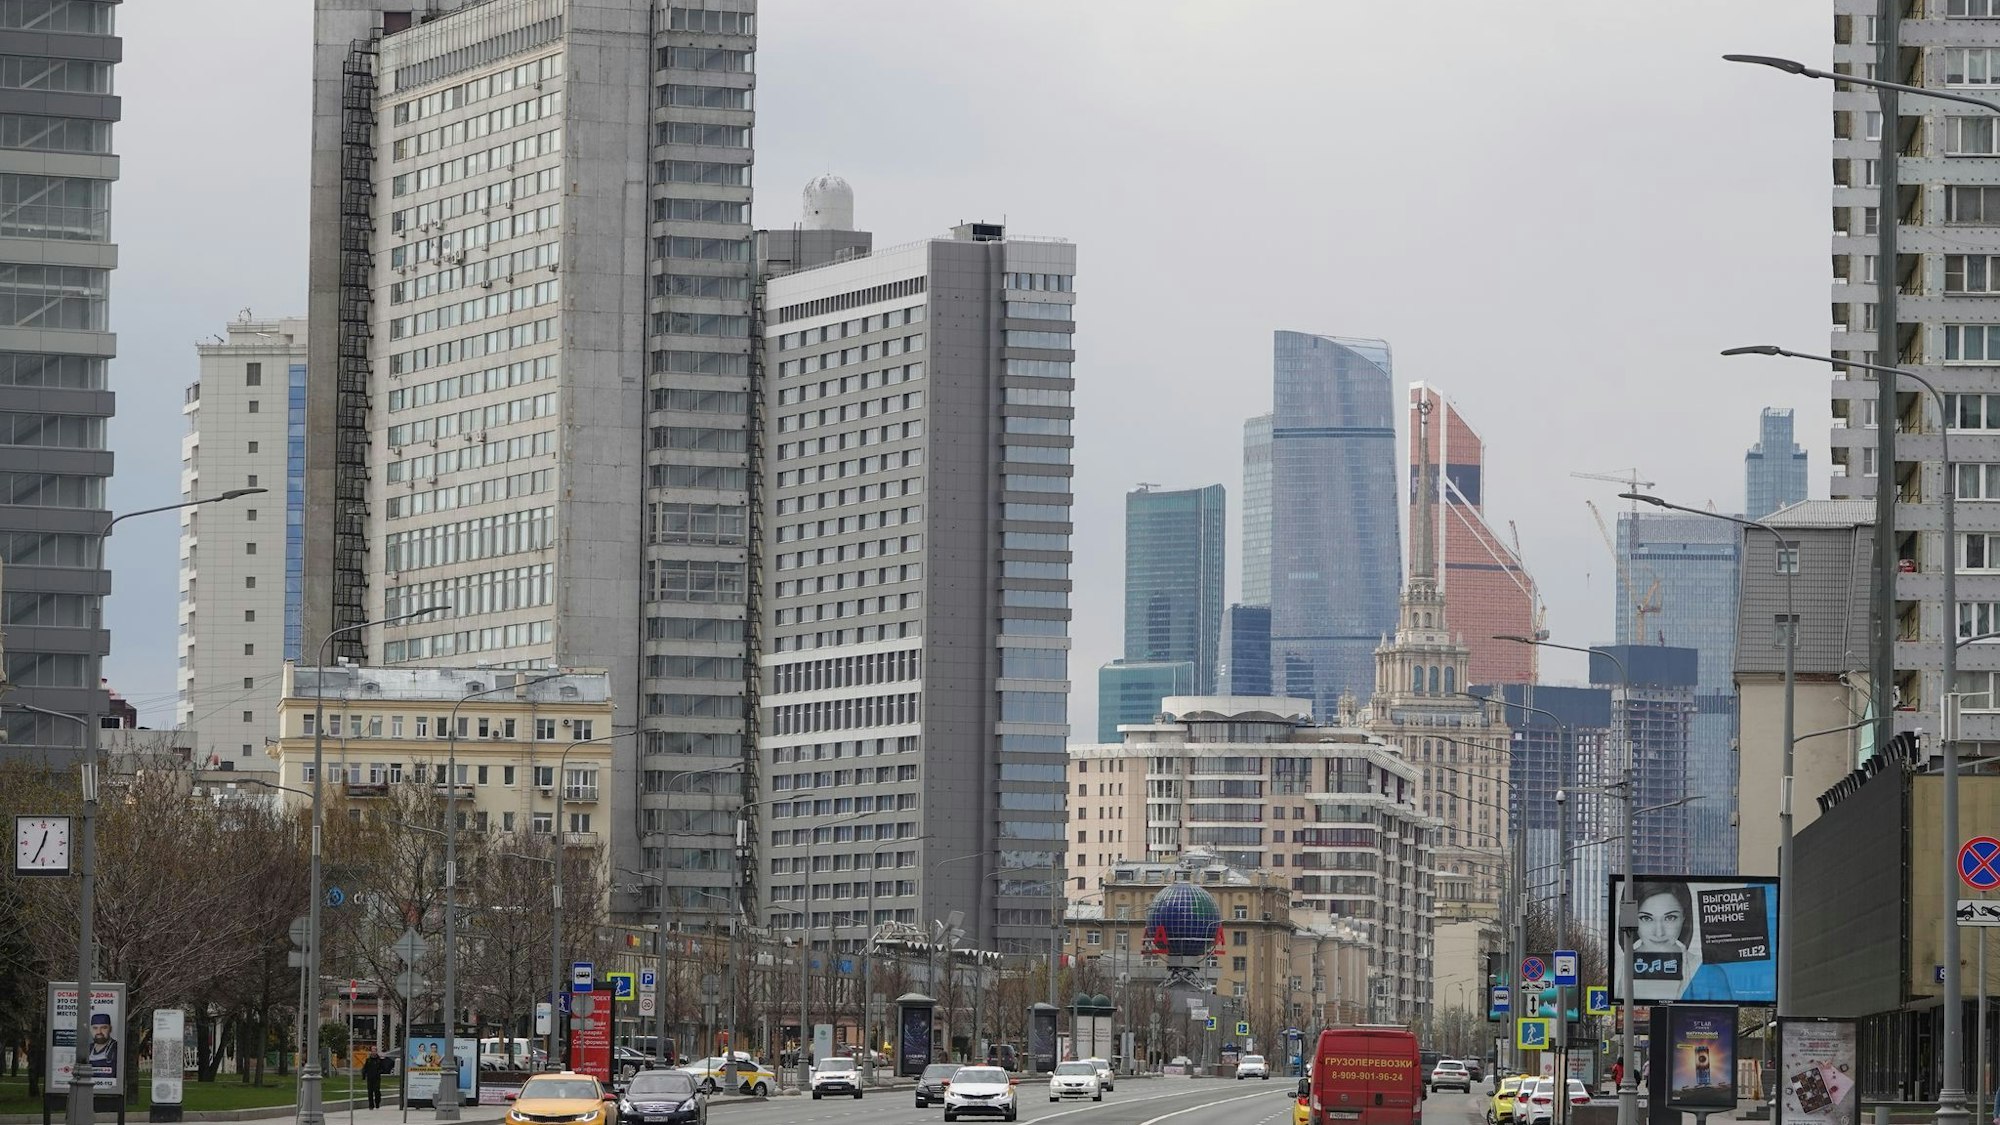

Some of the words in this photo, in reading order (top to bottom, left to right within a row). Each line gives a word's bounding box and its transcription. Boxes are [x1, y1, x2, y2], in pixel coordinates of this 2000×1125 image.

[1702, 892, 1745, 904] ВЫГОДА
[1703, 902, 1749, 913] ПОНЯТИЕ
[1704, 912, 1745, 924] ЛИЧНОЕ
[1738, 945, 1766, 957] TELE2
[1325, 1057, 1413, 1068] ГРУЗОПЕРЕВОЗКИ
[1332, 1071, 1403, 1081] 8-909-901-96-24
